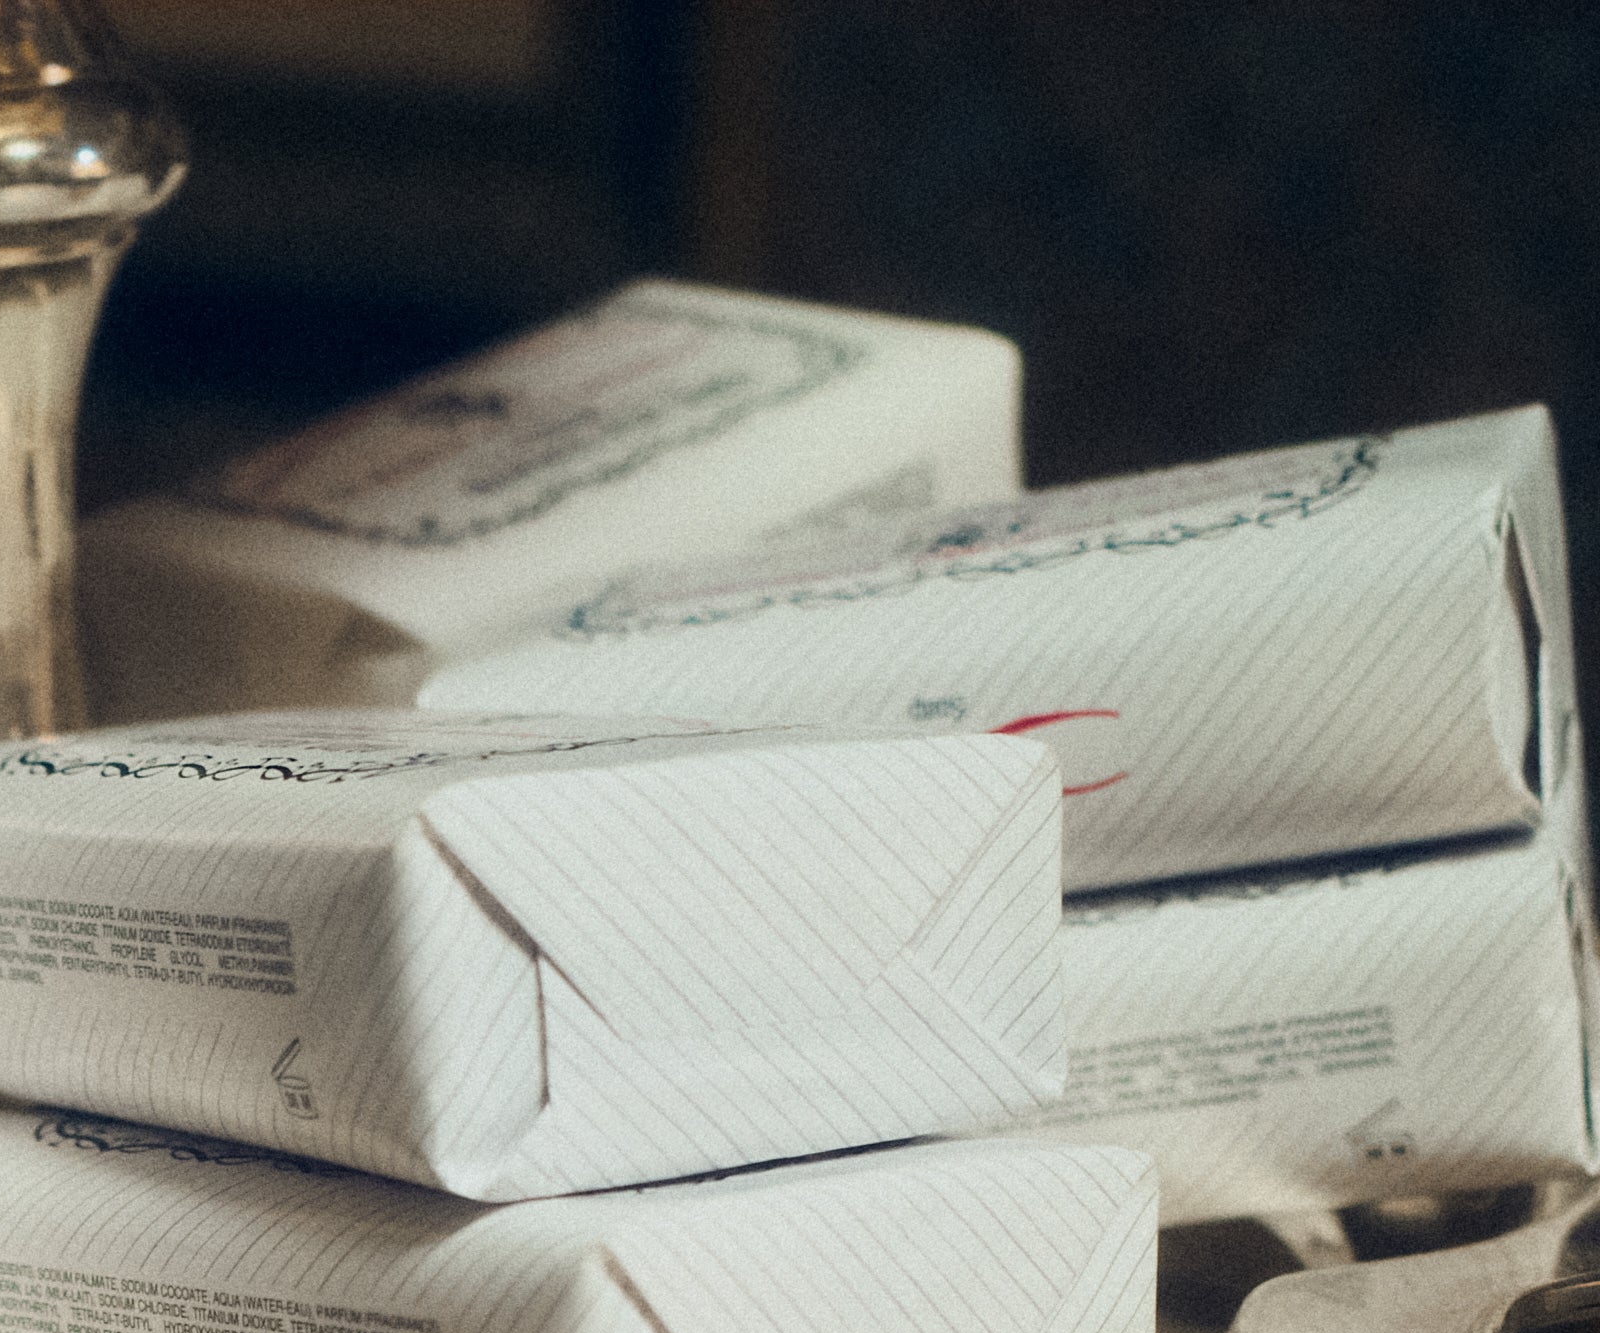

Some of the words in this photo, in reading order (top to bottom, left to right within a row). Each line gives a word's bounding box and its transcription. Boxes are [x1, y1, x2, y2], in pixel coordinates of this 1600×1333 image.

[121, 1278, 157, 1296] SODIUM
[213, 1291, 240, 1308] AQUA
[98, 1293, 134, 1311] SODIUM
[192, 1306, 238, 1326] TITANIUM
